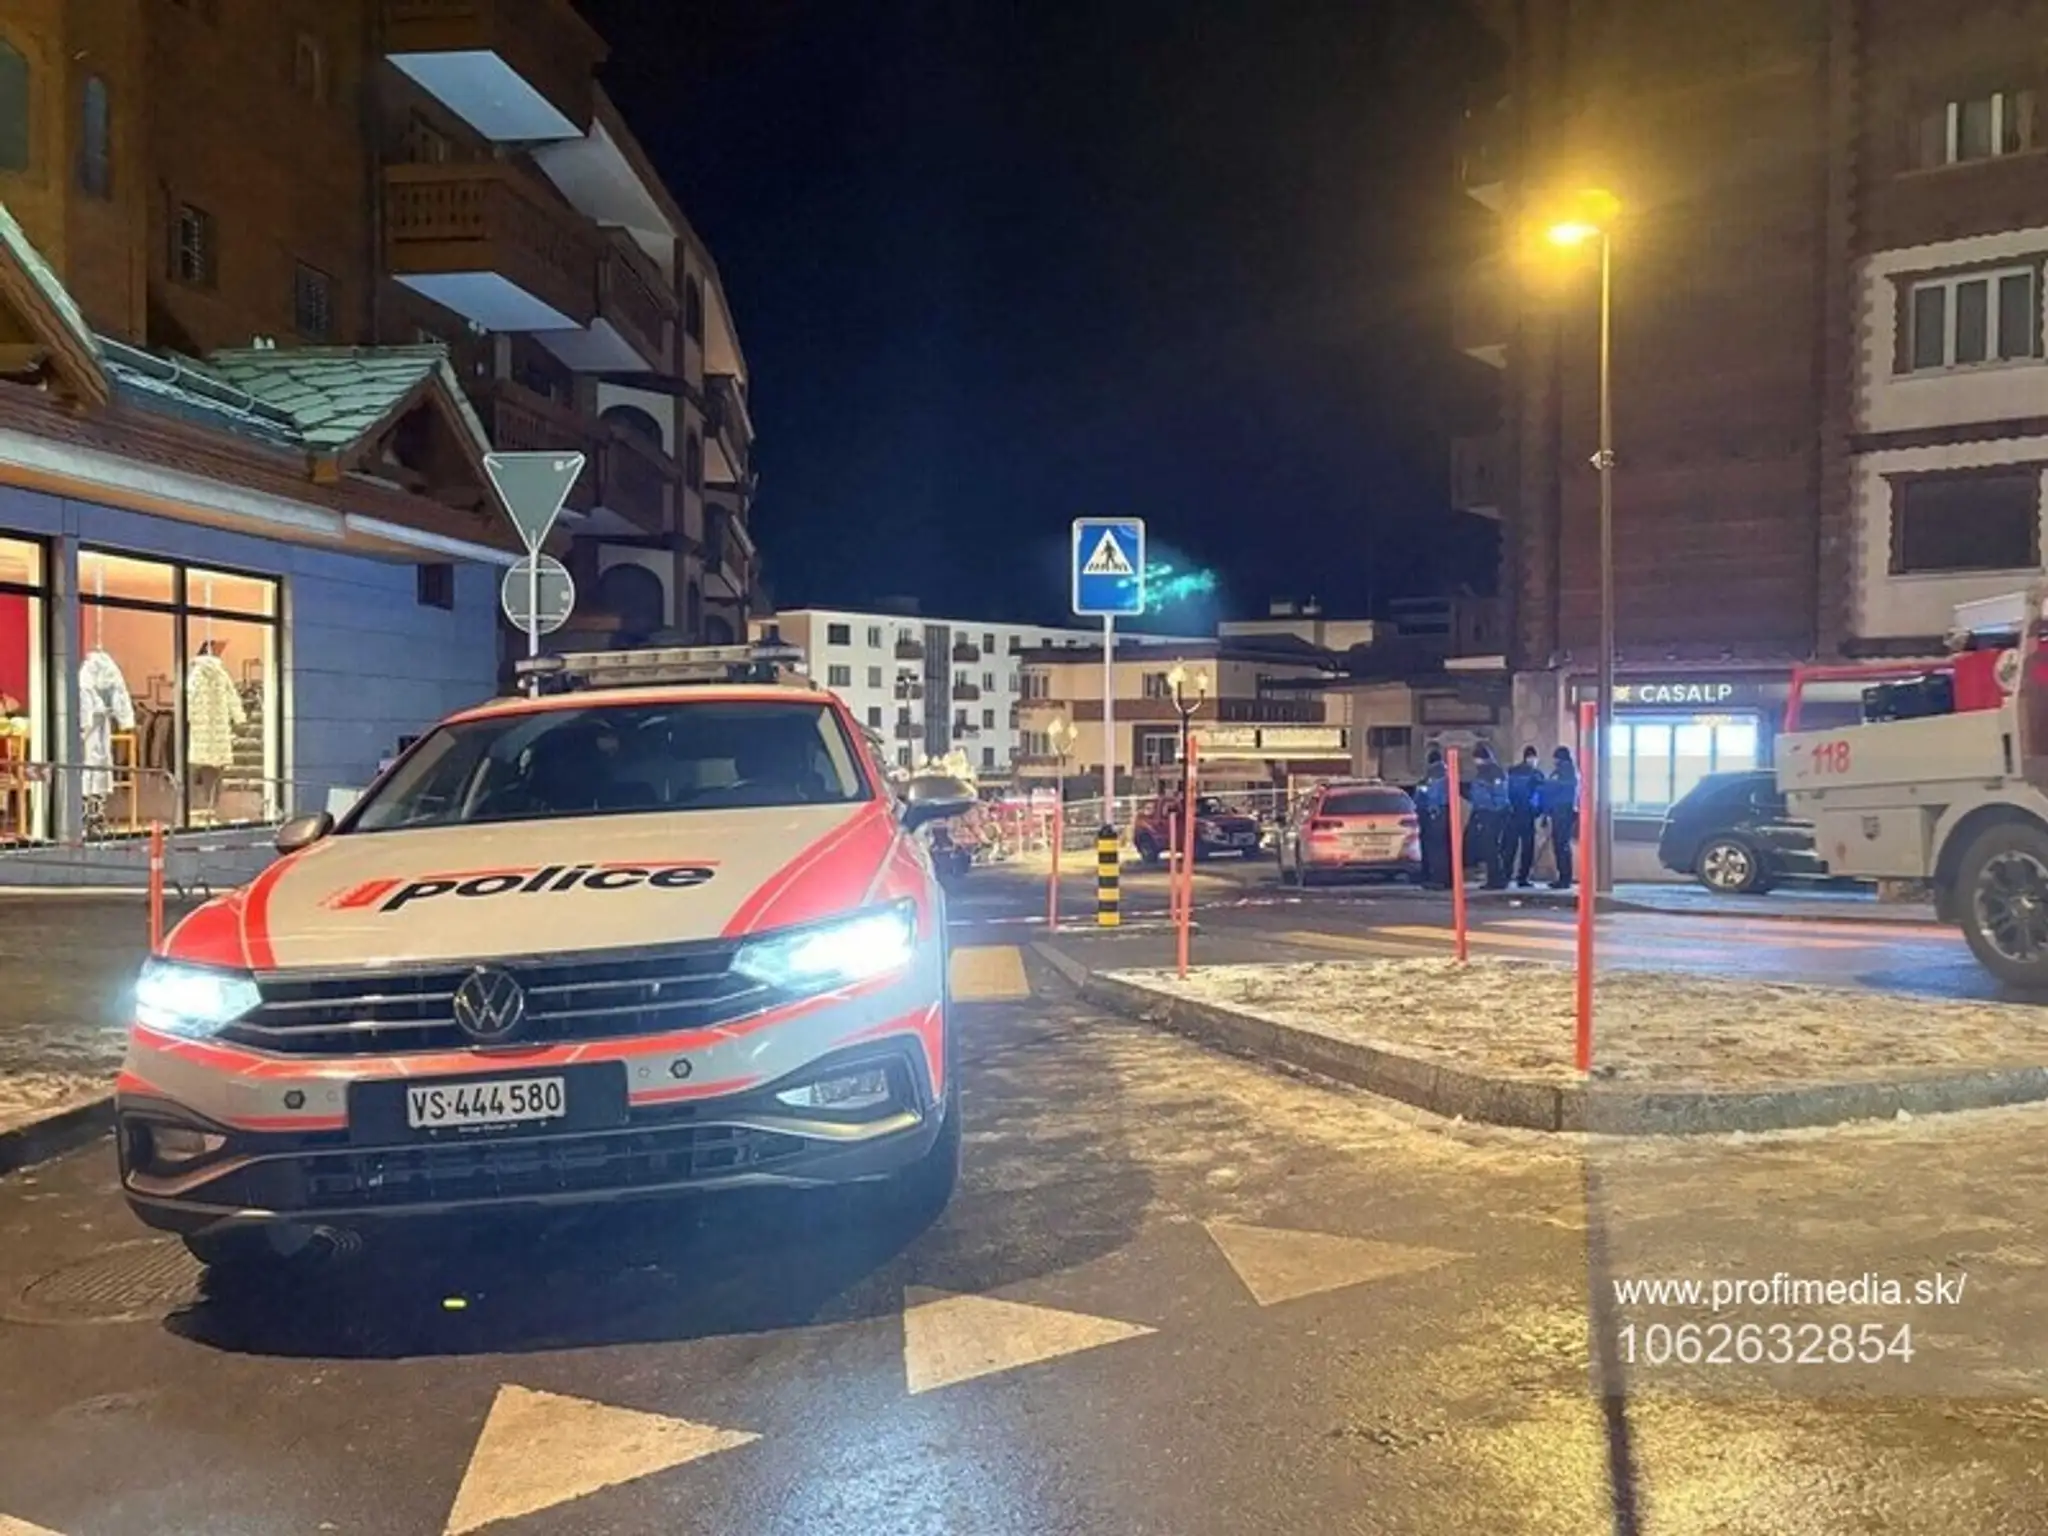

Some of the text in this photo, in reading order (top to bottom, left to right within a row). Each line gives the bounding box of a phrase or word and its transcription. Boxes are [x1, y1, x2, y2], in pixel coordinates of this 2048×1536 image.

[1639, 683, 1733, 703] CASALP
[1811, 740, 1851, 775] 118
[379, 864, 716, 913] police
